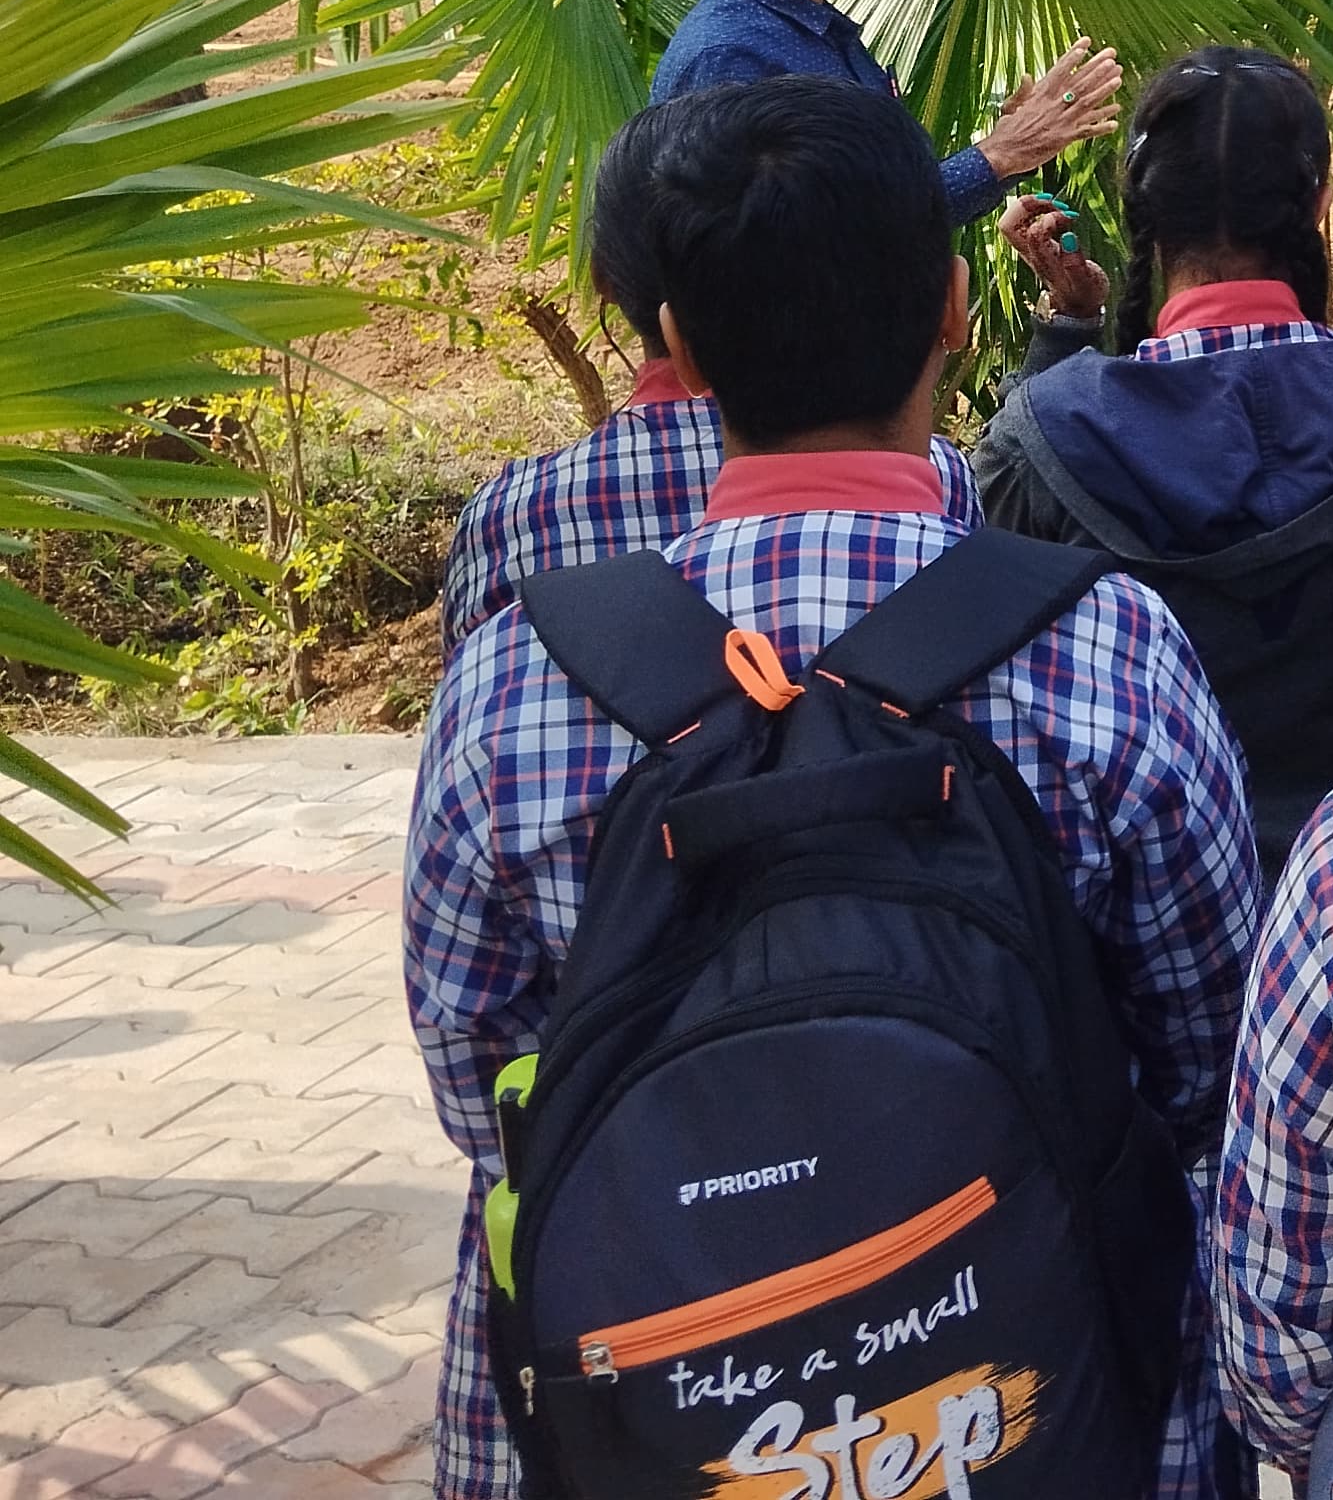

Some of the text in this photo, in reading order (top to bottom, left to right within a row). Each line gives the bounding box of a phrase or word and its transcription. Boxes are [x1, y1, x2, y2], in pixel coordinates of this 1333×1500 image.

[704, 1157, 818, 1199] PRIORITY
[668, 1265, 979, 1409] take a small
[728, 1385, 1003, 1500] Step
